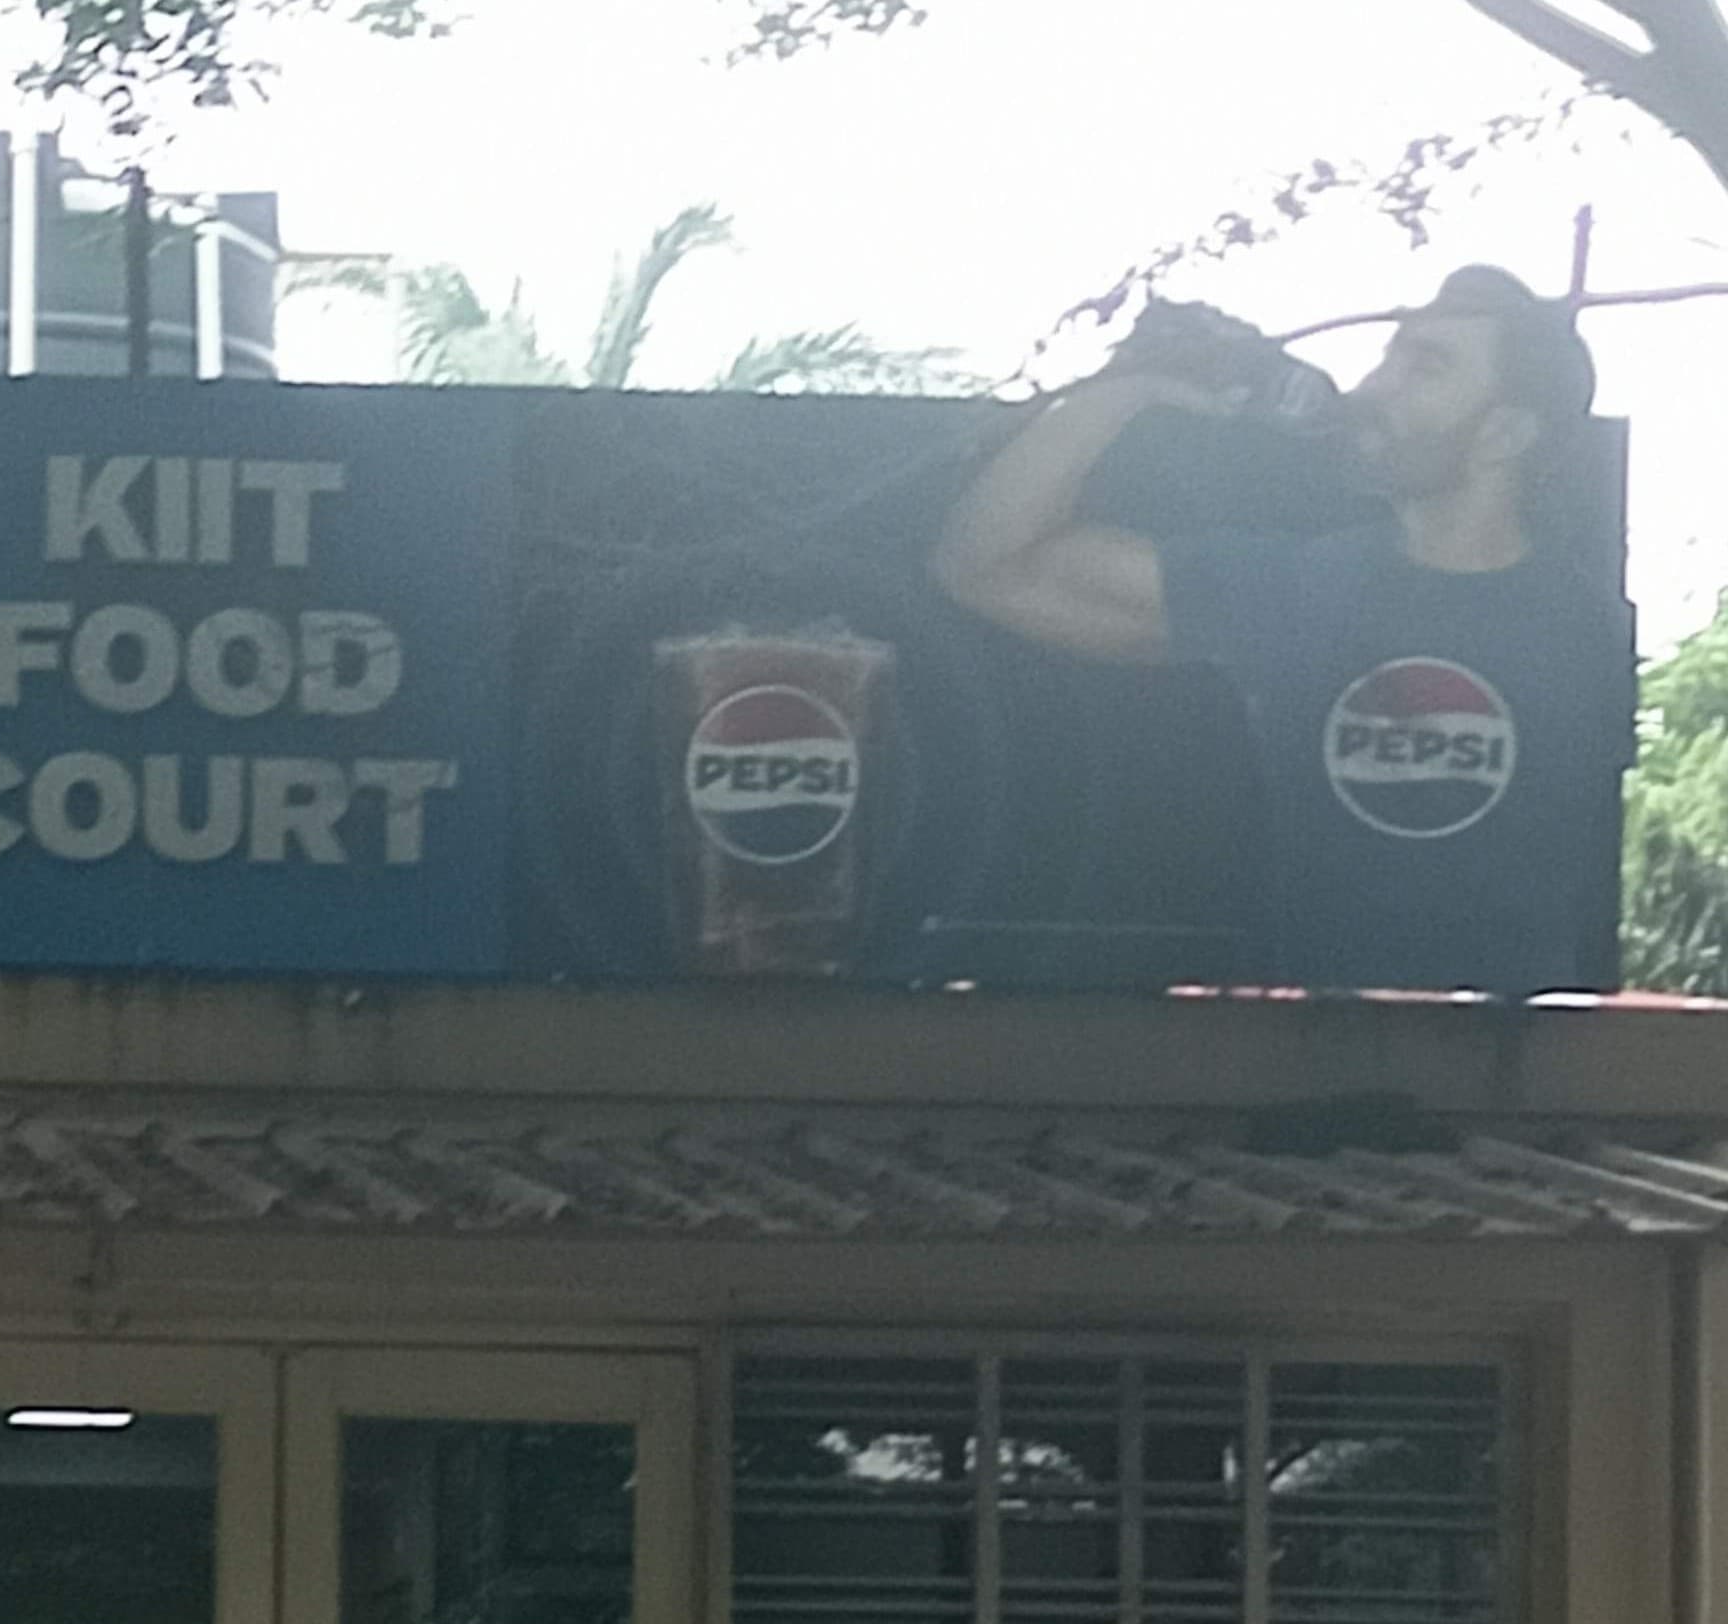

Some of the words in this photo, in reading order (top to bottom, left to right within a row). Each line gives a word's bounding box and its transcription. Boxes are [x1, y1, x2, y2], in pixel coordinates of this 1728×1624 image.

[44, 455, 345, 567] KIIT
[1335, 725, 1506, 774] PEPSI
[694, 754, 855, 795] PEPSI
